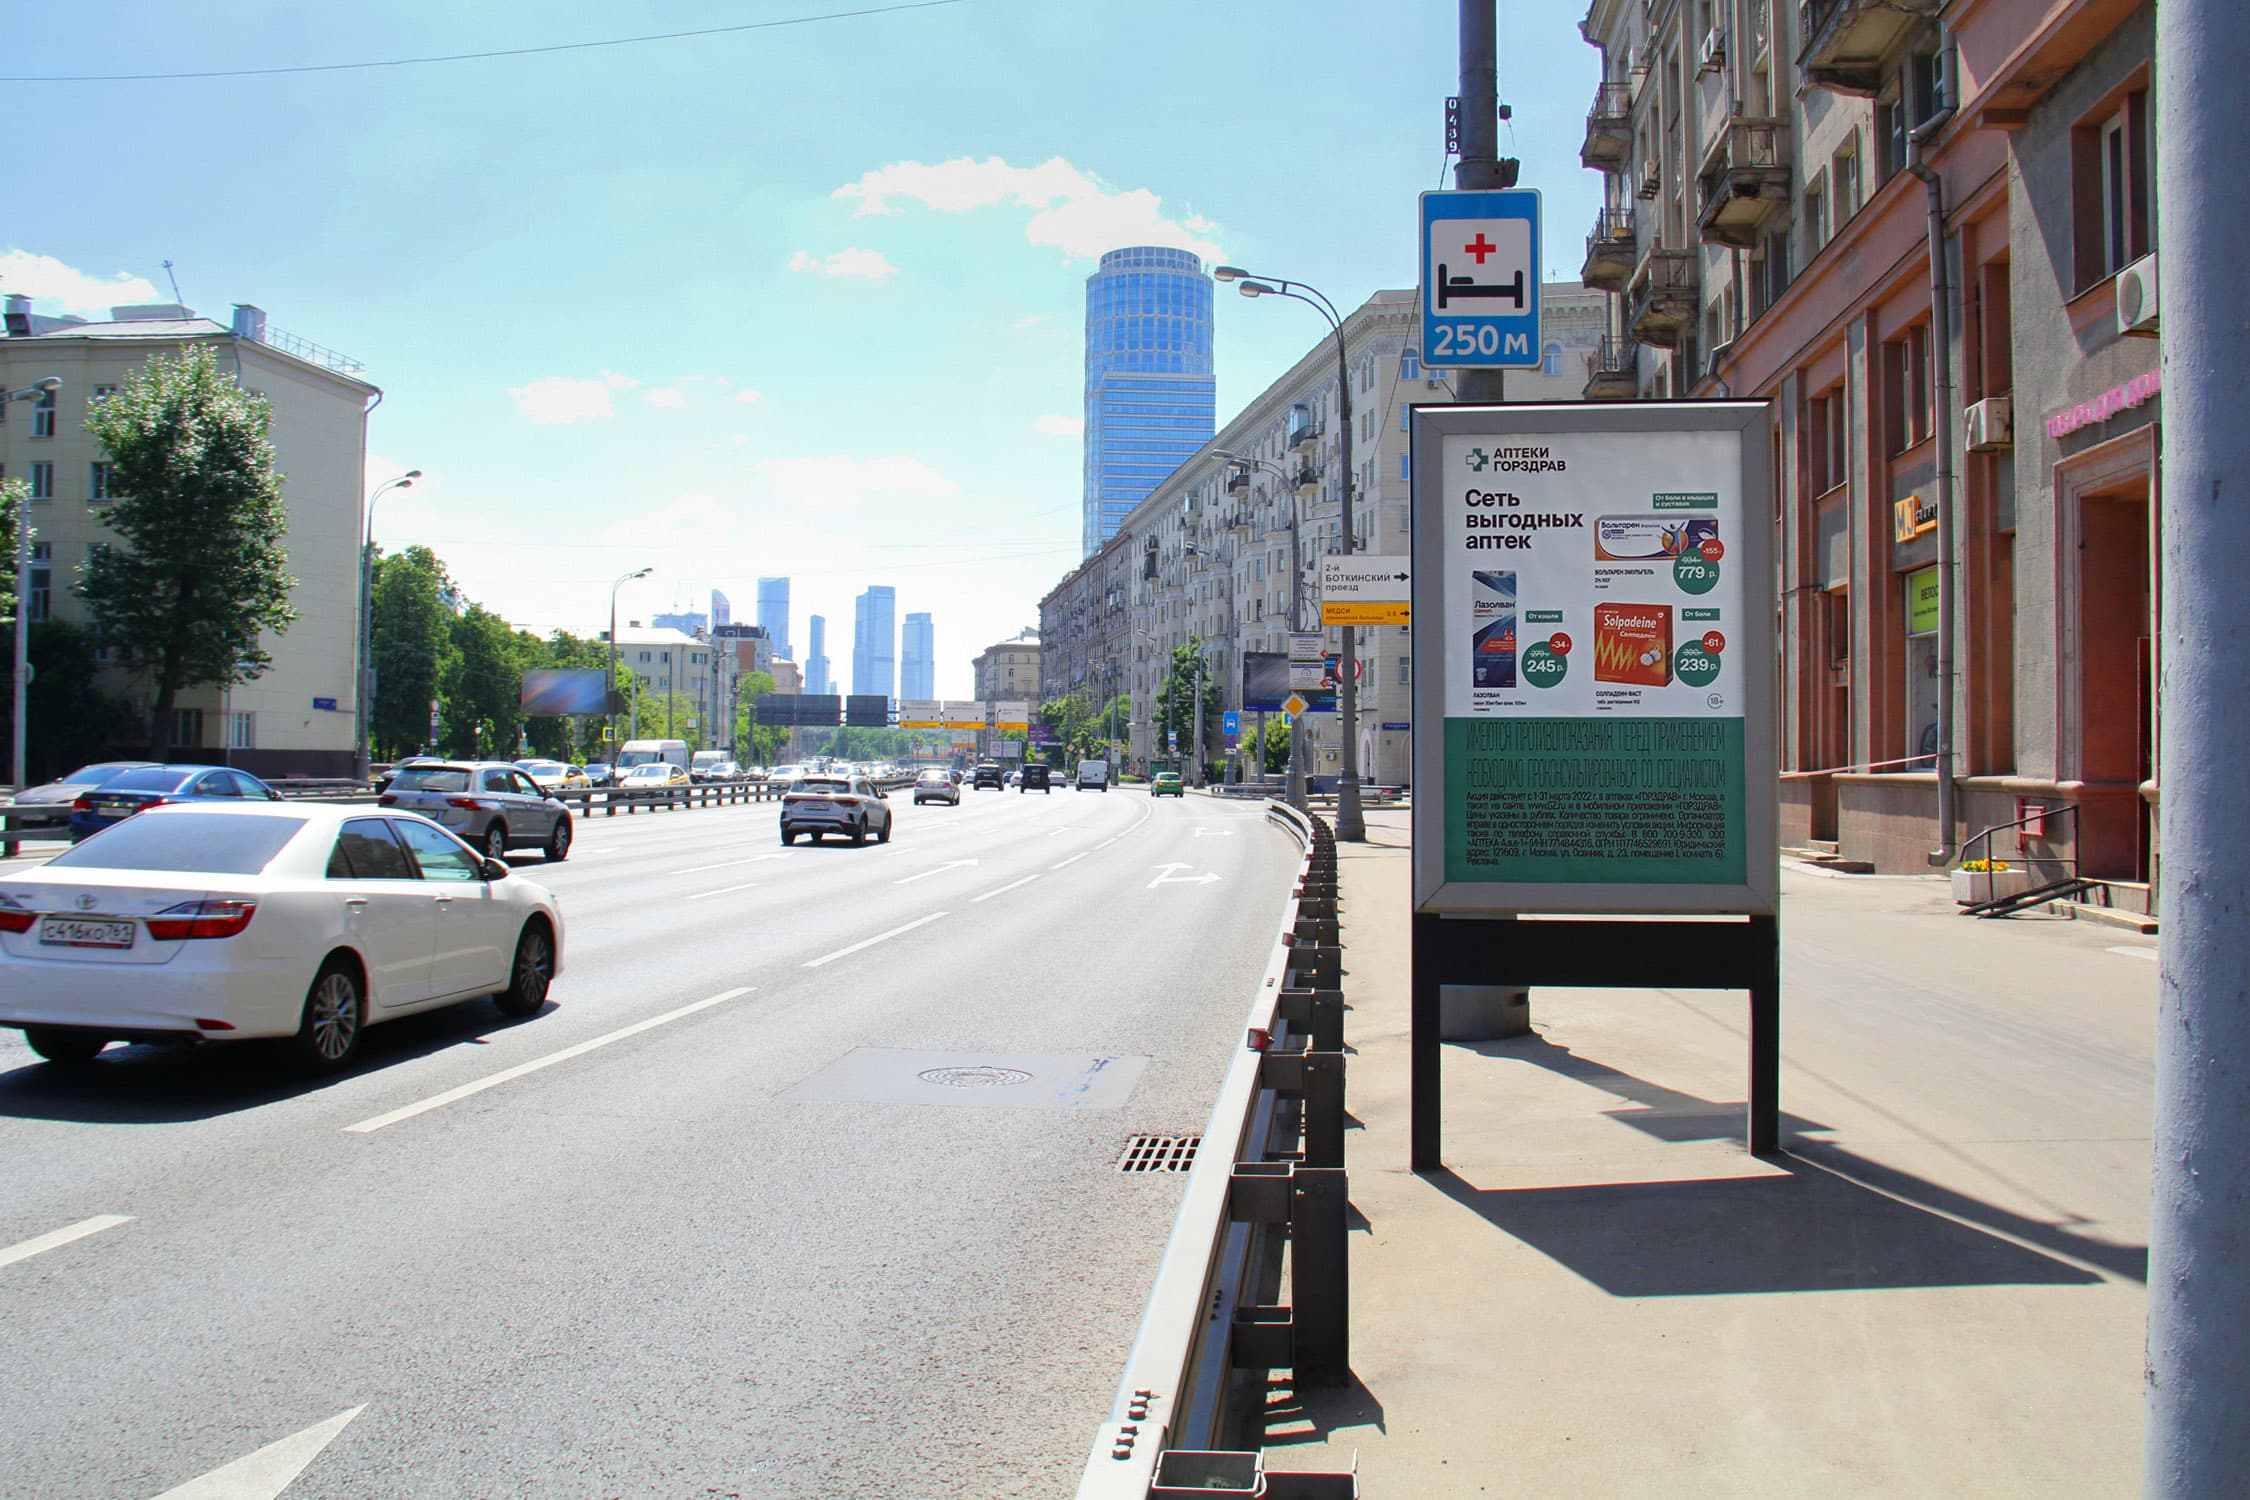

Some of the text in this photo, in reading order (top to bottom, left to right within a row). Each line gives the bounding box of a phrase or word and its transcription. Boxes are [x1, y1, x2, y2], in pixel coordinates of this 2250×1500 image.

[1434, 325, 1499, 356] 250
[1494, 448, 1550, 459] АПТЕКИ
[1494, 461, 1567, 473] ГОРЗДРАВ
[1465, 489, 1520, 507] Сеть
[1466, 514, 1584, 530] выгодных
[1466, 534, 1532, 549] аптек
[1325, 572, 1391, 582] БОТКИНСКИЙ
[1678, 566, 1705, 579] 779
[1474, 601, 1515, 609] Лазолван
[1604, 614, 1657, 629] Solpadeine
[1527, 660, 1555, 672] 245
[1680, 658, 1709, 671] 239
[1711, 697, 1723, 705] 18+
[1467, 722, 1511, 751] ИМЕЮТСЯ
